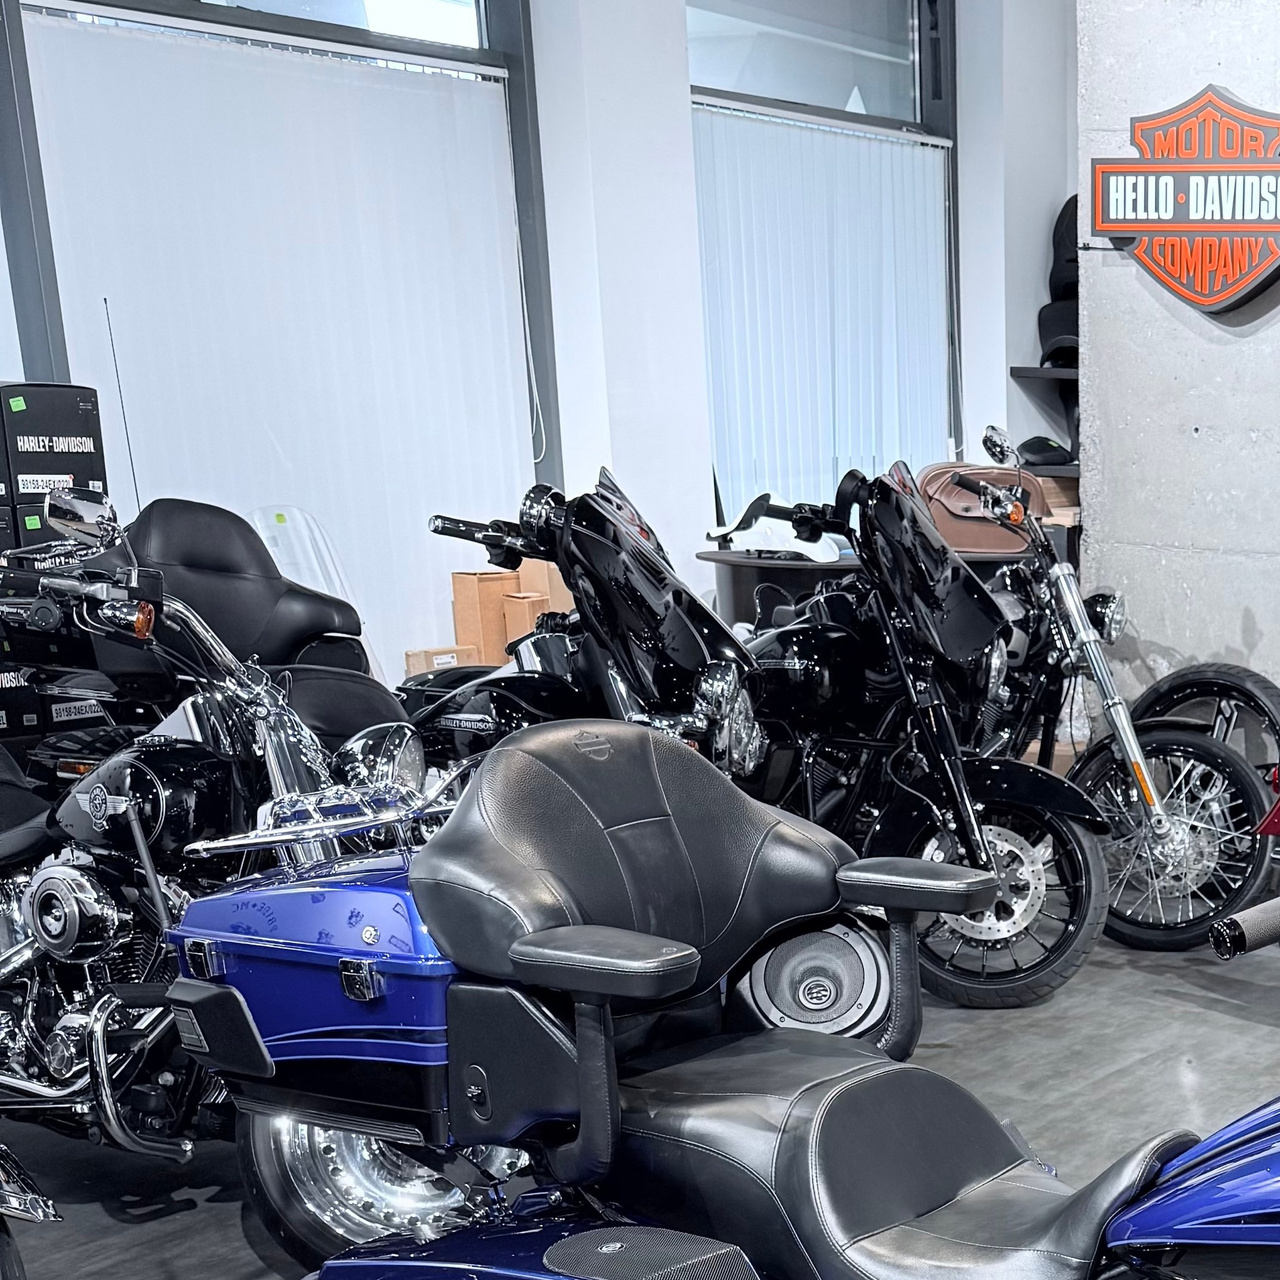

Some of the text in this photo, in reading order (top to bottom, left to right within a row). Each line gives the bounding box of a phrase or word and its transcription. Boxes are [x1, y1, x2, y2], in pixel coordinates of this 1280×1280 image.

[1154, 107, 1265, 159] MOTOR
[1109, 175, 1174, 220] HELLO
[1152, 237, 1263, 294] COMPANY
[16, 435, 96, 453] HARLEY-DAVIDSON
